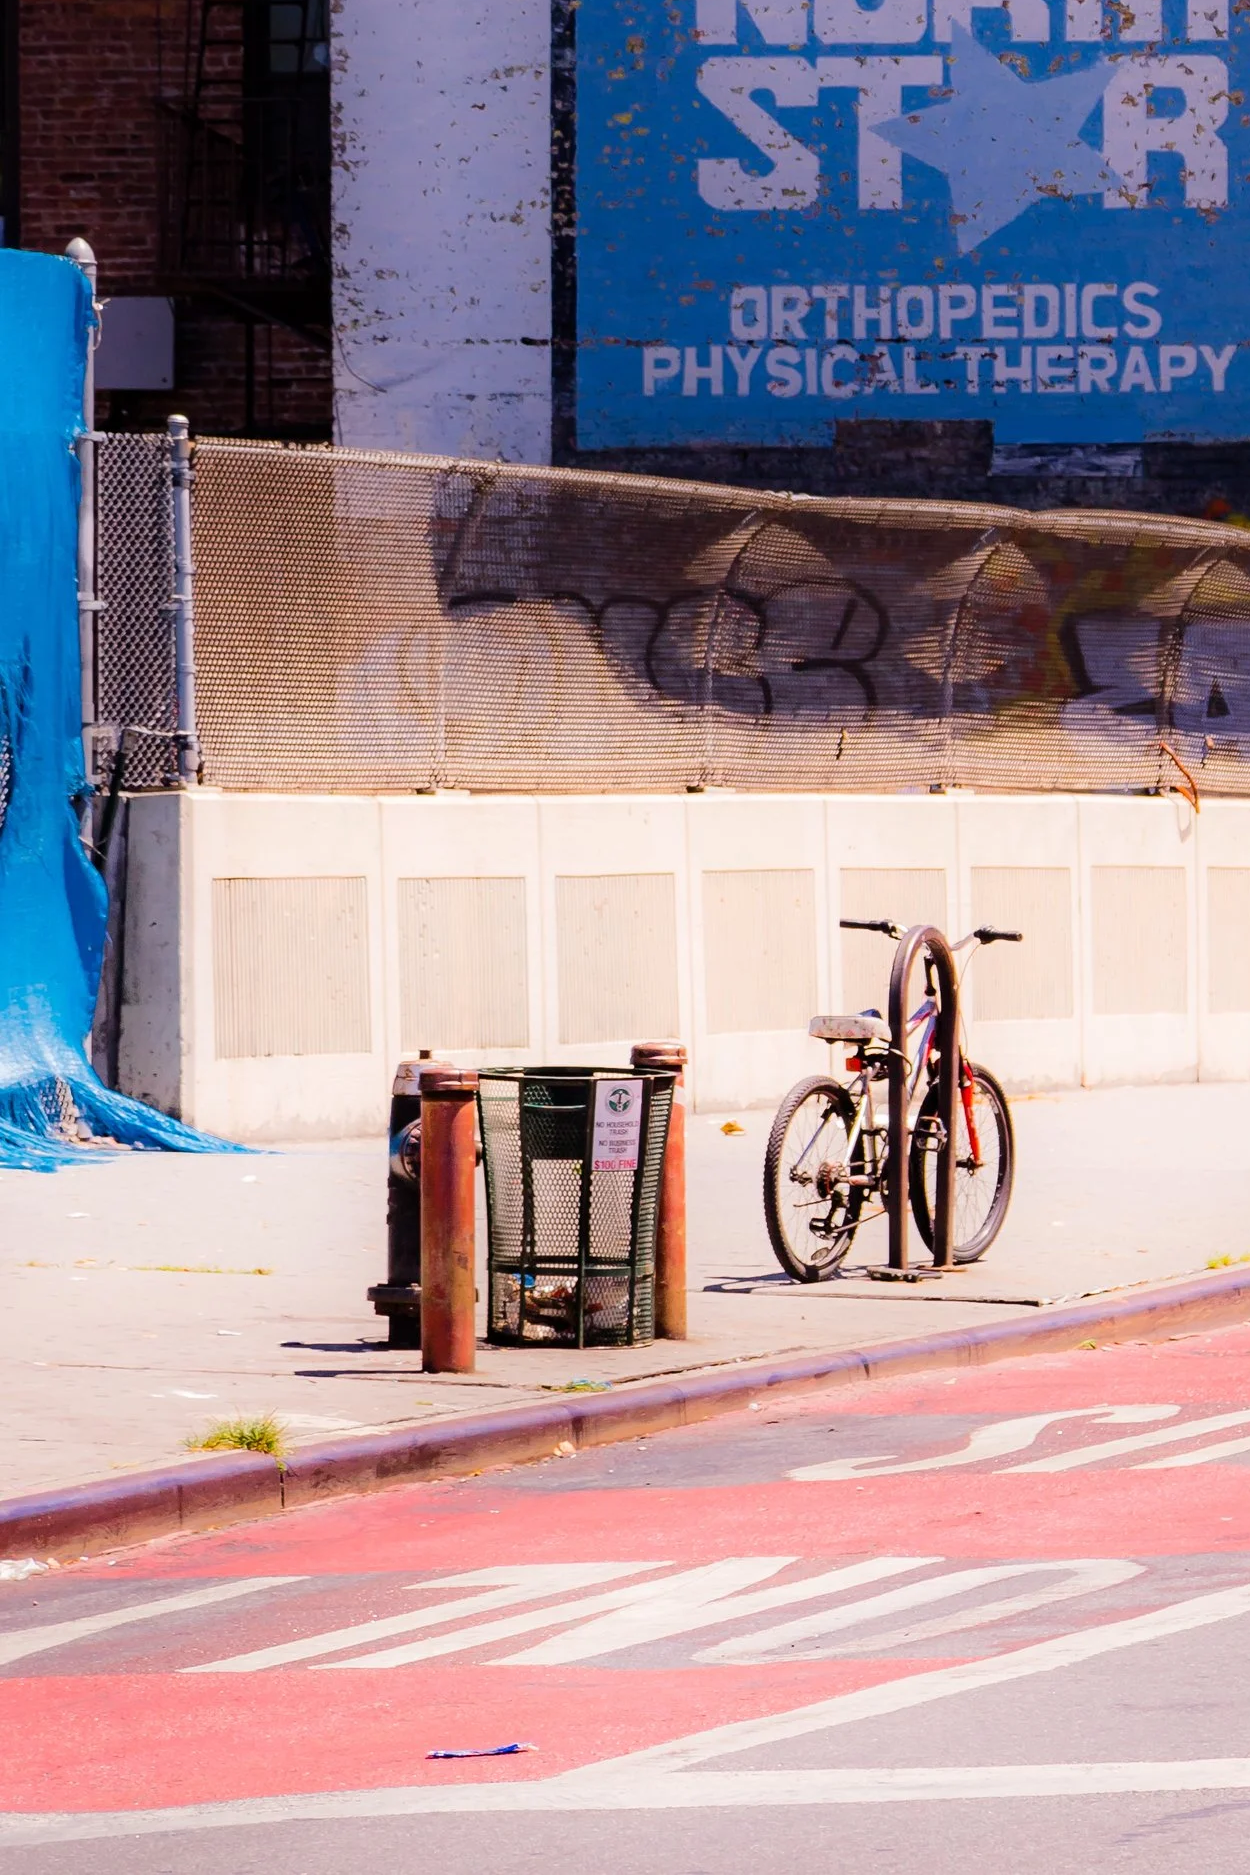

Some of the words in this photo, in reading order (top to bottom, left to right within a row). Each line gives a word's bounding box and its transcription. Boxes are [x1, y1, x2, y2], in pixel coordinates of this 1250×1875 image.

[695, 54, 1231, 212] STR
[729, 281, 1163, 341] ORTHOPEDICS
[642, 345, 939, 398] PHYSICAL
[964, 344, 1238, 396] THERAPY
[606, 1120, 640, 1128] HOUSEHOLD
[609, 1139, 636, 1147] BUSINESS
[594, 1160, 616, 1170] $100
[618, 1159, 637, 1168] FINE
